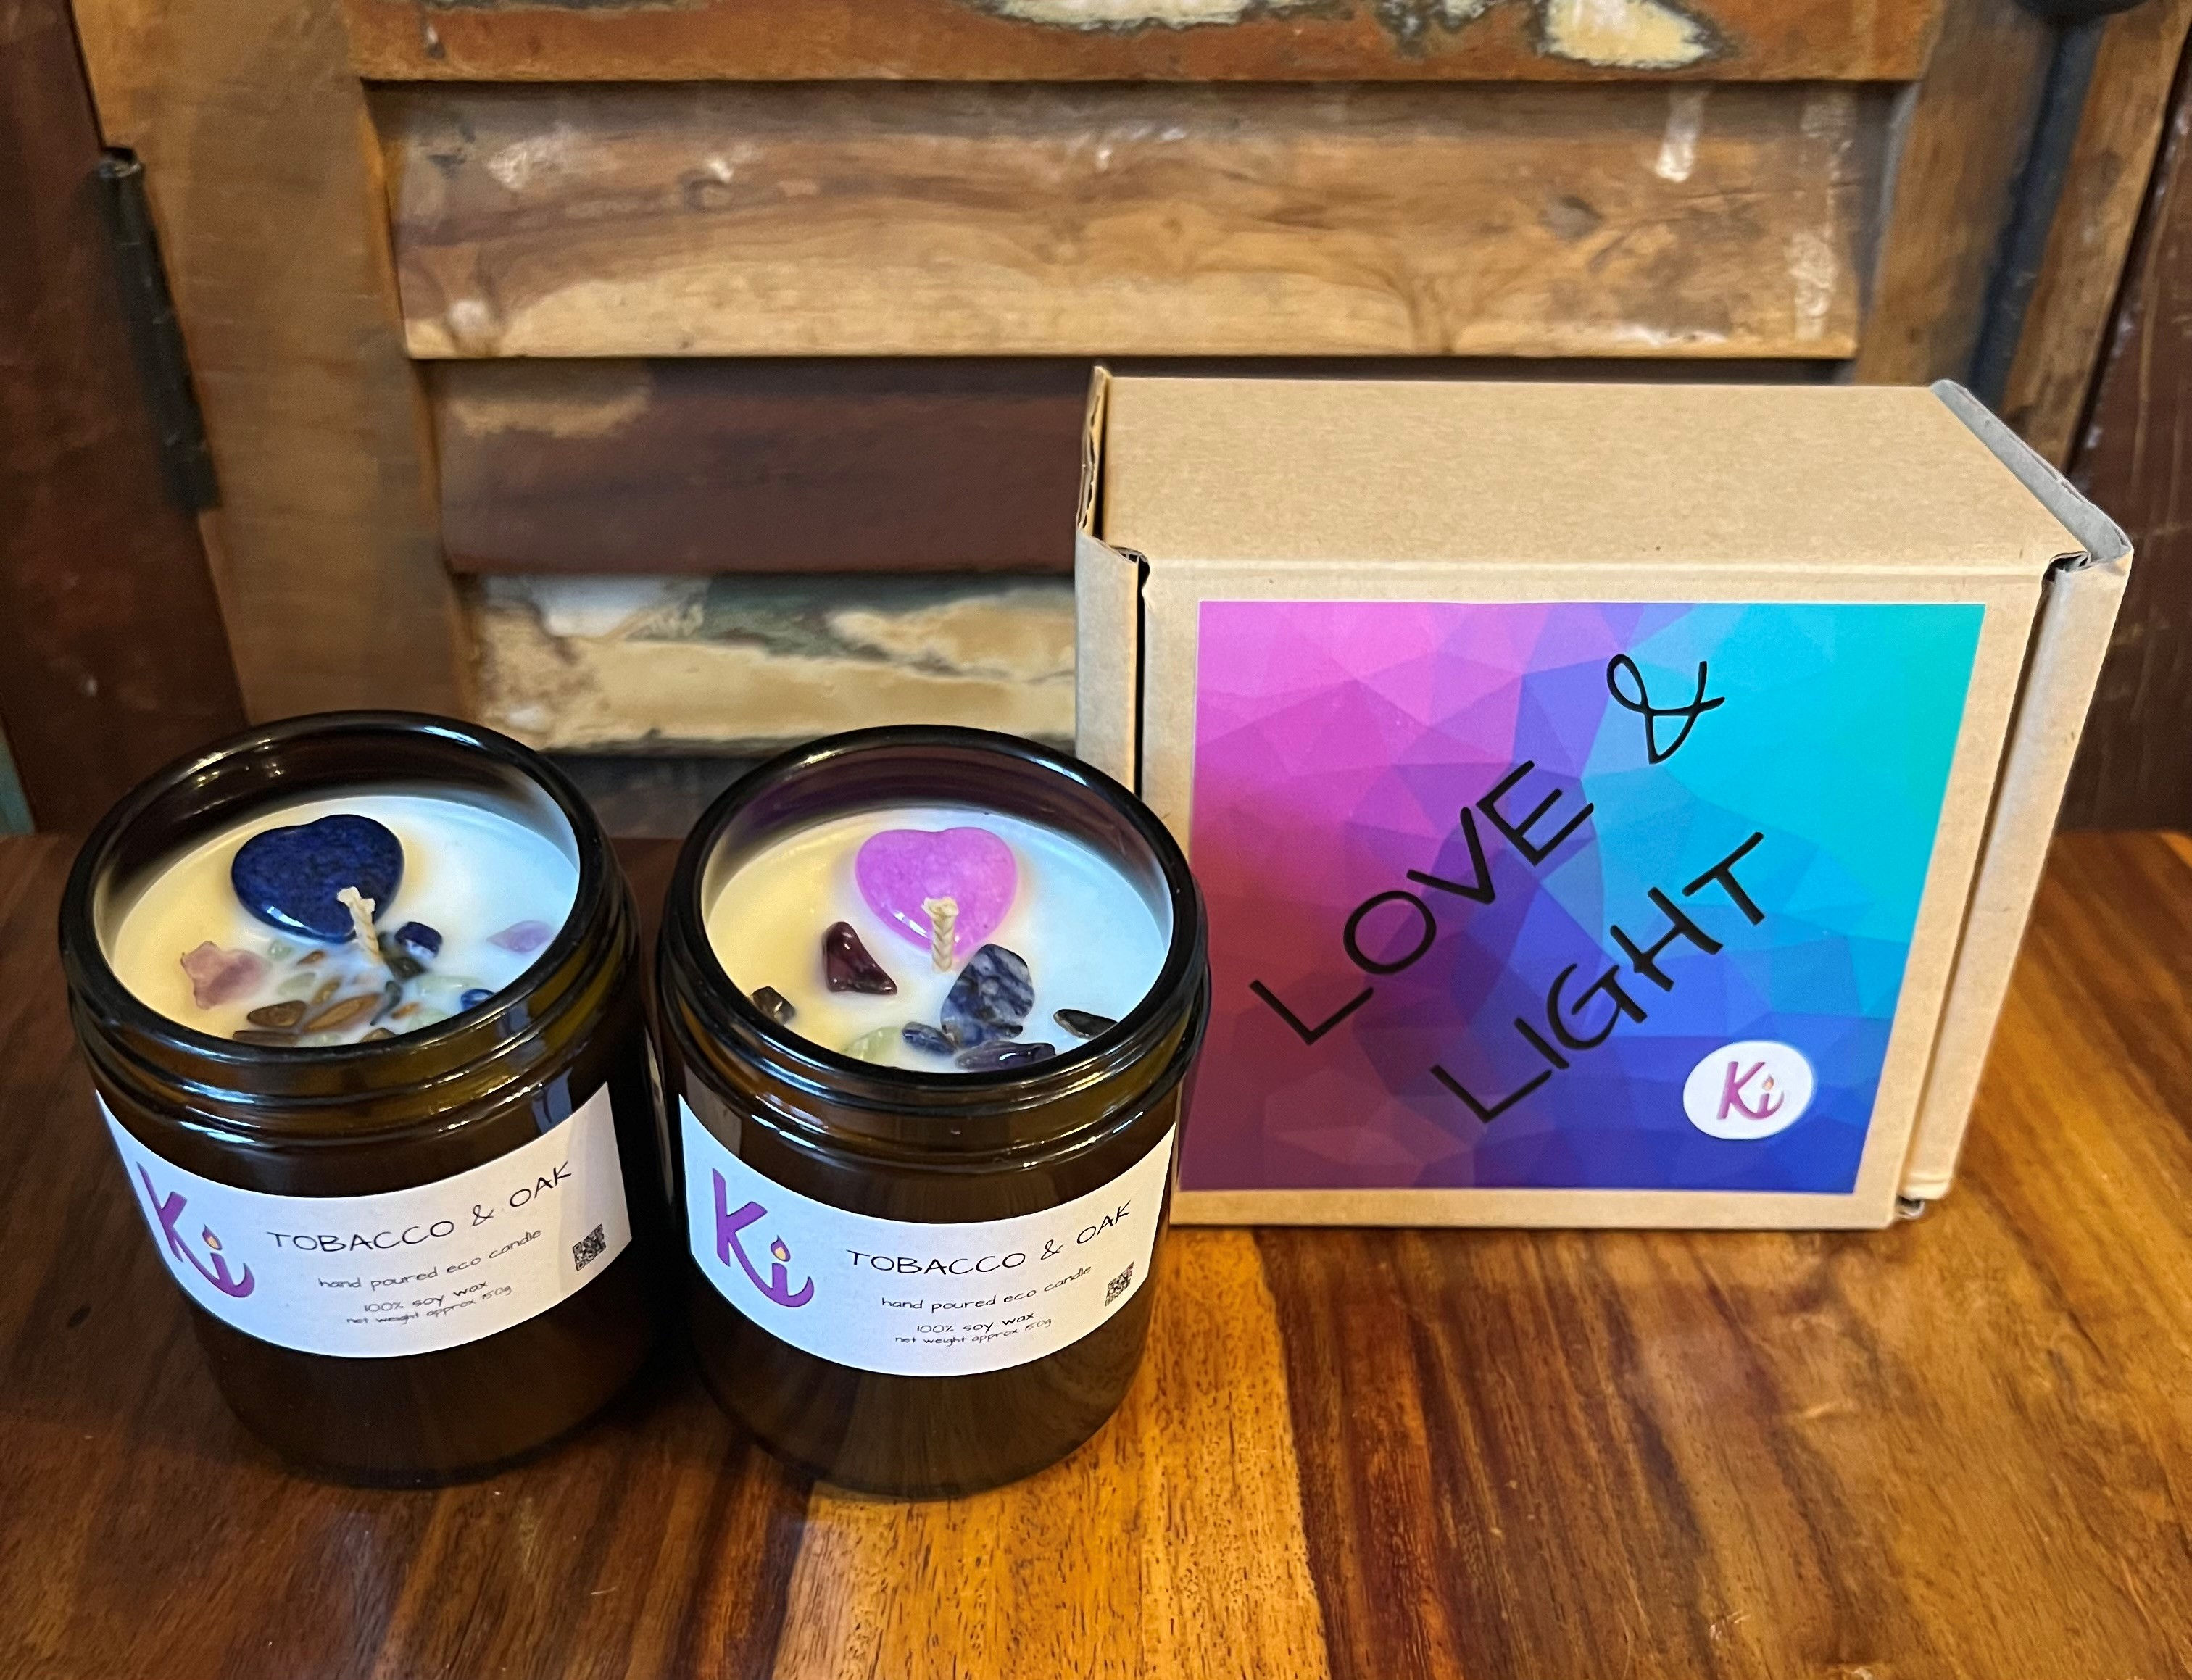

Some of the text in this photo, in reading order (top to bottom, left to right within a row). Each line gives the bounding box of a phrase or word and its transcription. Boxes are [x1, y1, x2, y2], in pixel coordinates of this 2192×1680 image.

[1250, 654, 1724, 1046] LOVE &
[1431, 832, 1764, 1123] LIGHT
[1716, 1060, 1784, 1120] Ki
[137, 1160, 255, 1298] Ki
[267, 1160, 572, 1252] TOBACCO & OAK
[713, 1168, 814, 1308] Ki
[318, 1228, 541, 1292] hand poured eco candle
[847, 1201, 1131, 1276] TOBACCO & OAK
[346, 1316, 368, 1325] net
[375, 1311, 420, 1325] weight
[426, 1299, 475, 1318] approx
[363, 1281, 489, 1313] 100% soy wax
[881, 1266, 1092, 1314] hand poured eco candle
[895, 1336, 916, 1344] net
[923, 1336, 966, 1349] weight
[971, 1328, 1018, 1342] approx
[916, 1311, 1034, 1336] 100% soy wax
